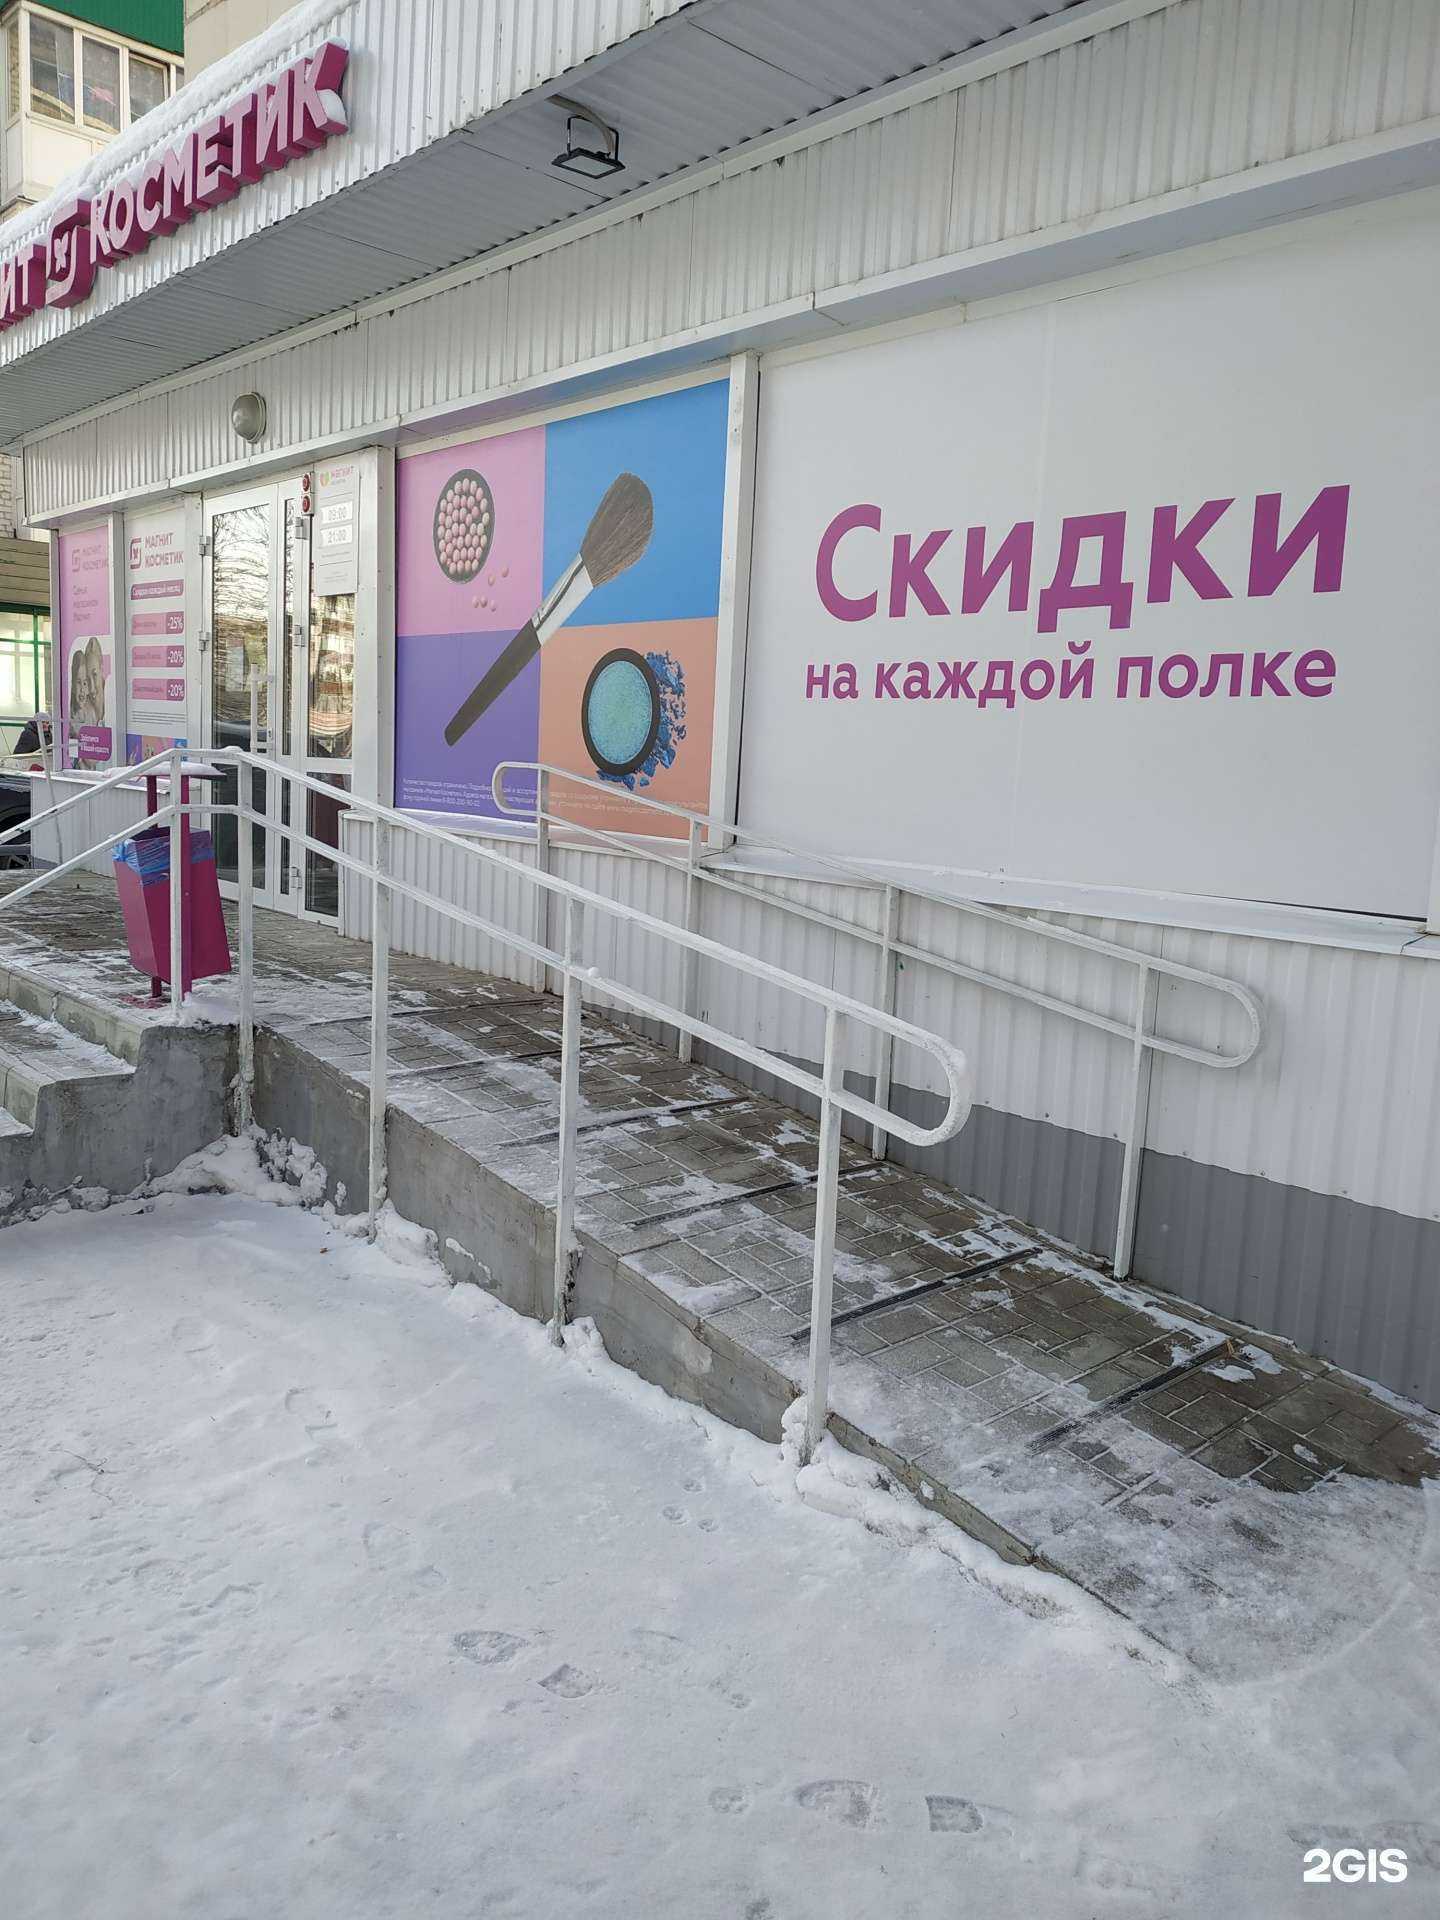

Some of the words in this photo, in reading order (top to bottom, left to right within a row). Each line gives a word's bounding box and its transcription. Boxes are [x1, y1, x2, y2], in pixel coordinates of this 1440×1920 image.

[90, 41, 348, 268] КОСМЕТИК
[144, 532, 174, 548] МАГНИТ
[144, 551, 185, 568] КОСМЕТИК
[816, 484, 1350, 633] Скидки
[167, 616, 184, 630] -25%
[167, 651, 184, 663] -20%
[805, 664, 858, 699] на
[875, 641, 1094, 709] каждой
[1116, 649, 1336, 699] полке
[167, 684, 184, 697] -20%
